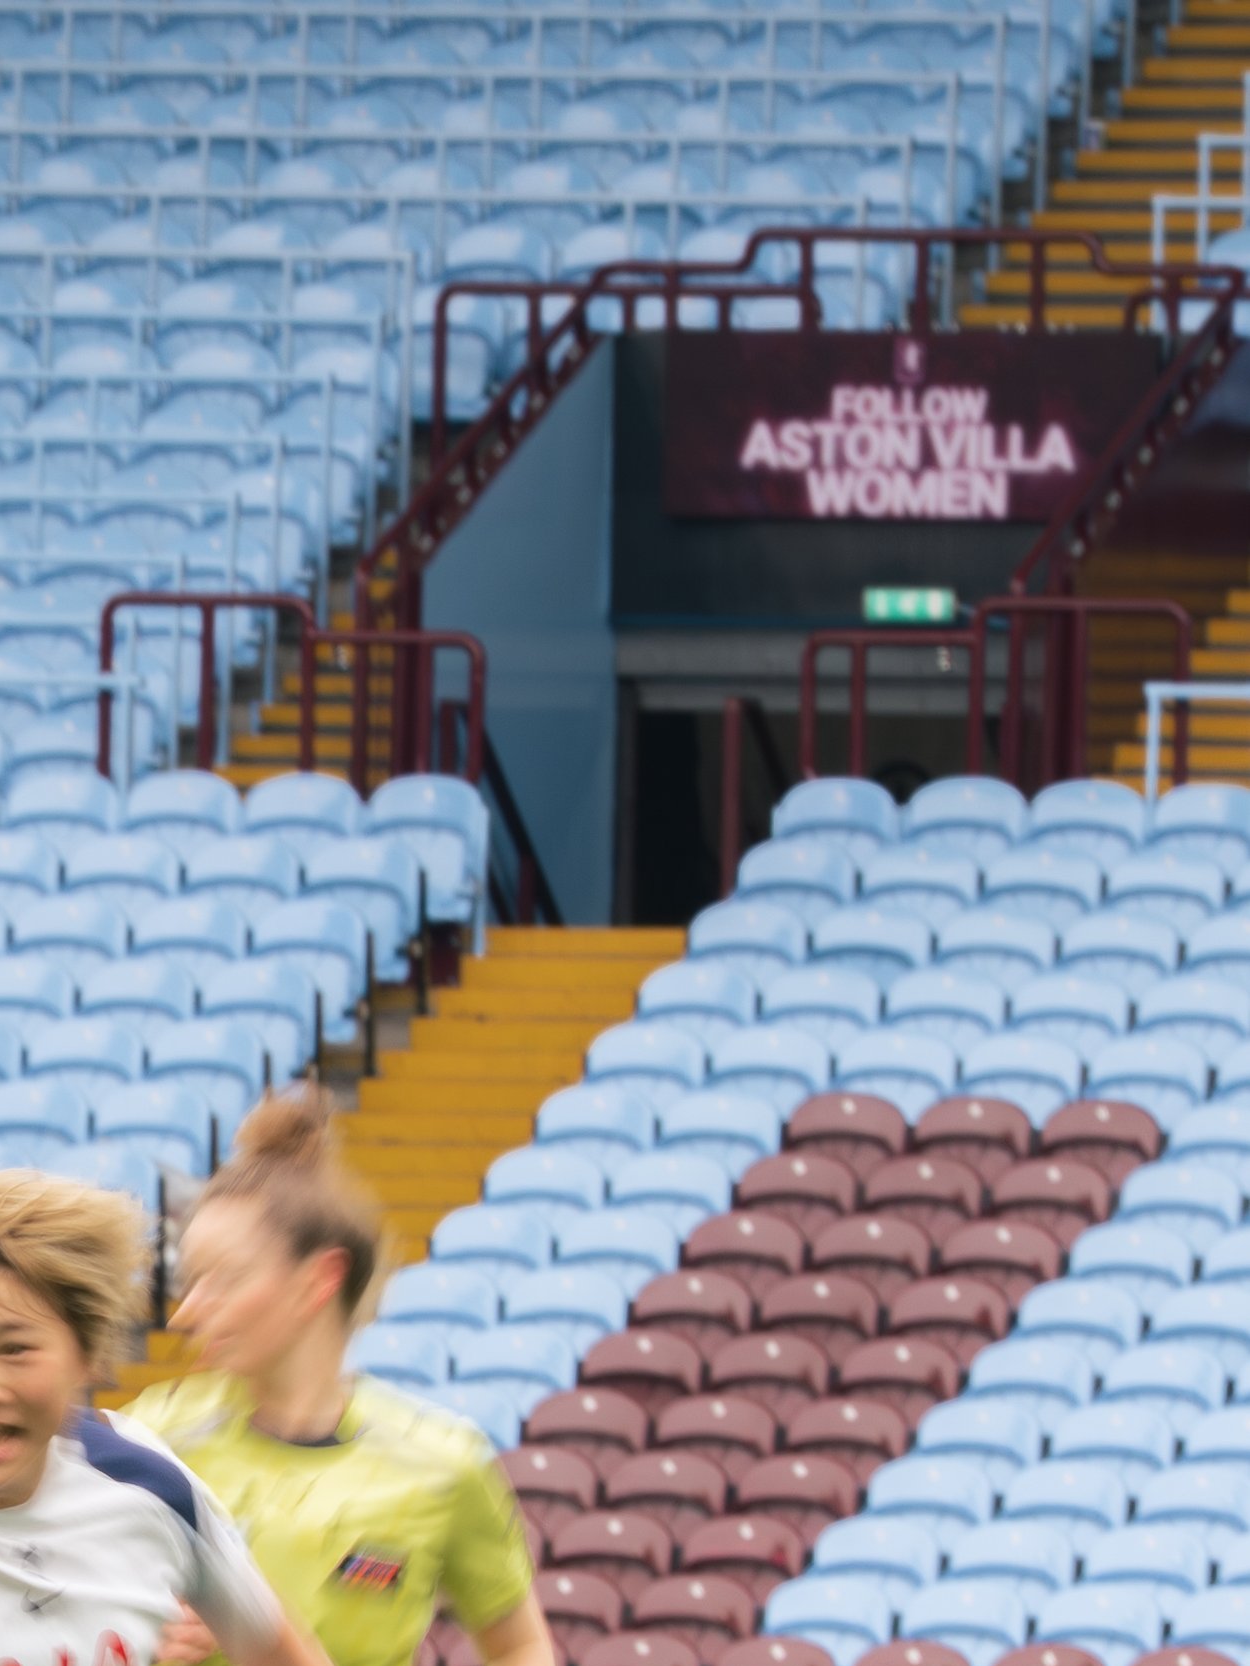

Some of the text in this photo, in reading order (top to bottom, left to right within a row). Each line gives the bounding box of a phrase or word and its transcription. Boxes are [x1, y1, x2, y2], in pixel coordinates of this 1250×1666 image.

[831, 386, 988, 424] FOLLOW
[741, 421, 1076, 473] ASTON VILLA
[806, 469, 1008, 519] WOMEN
